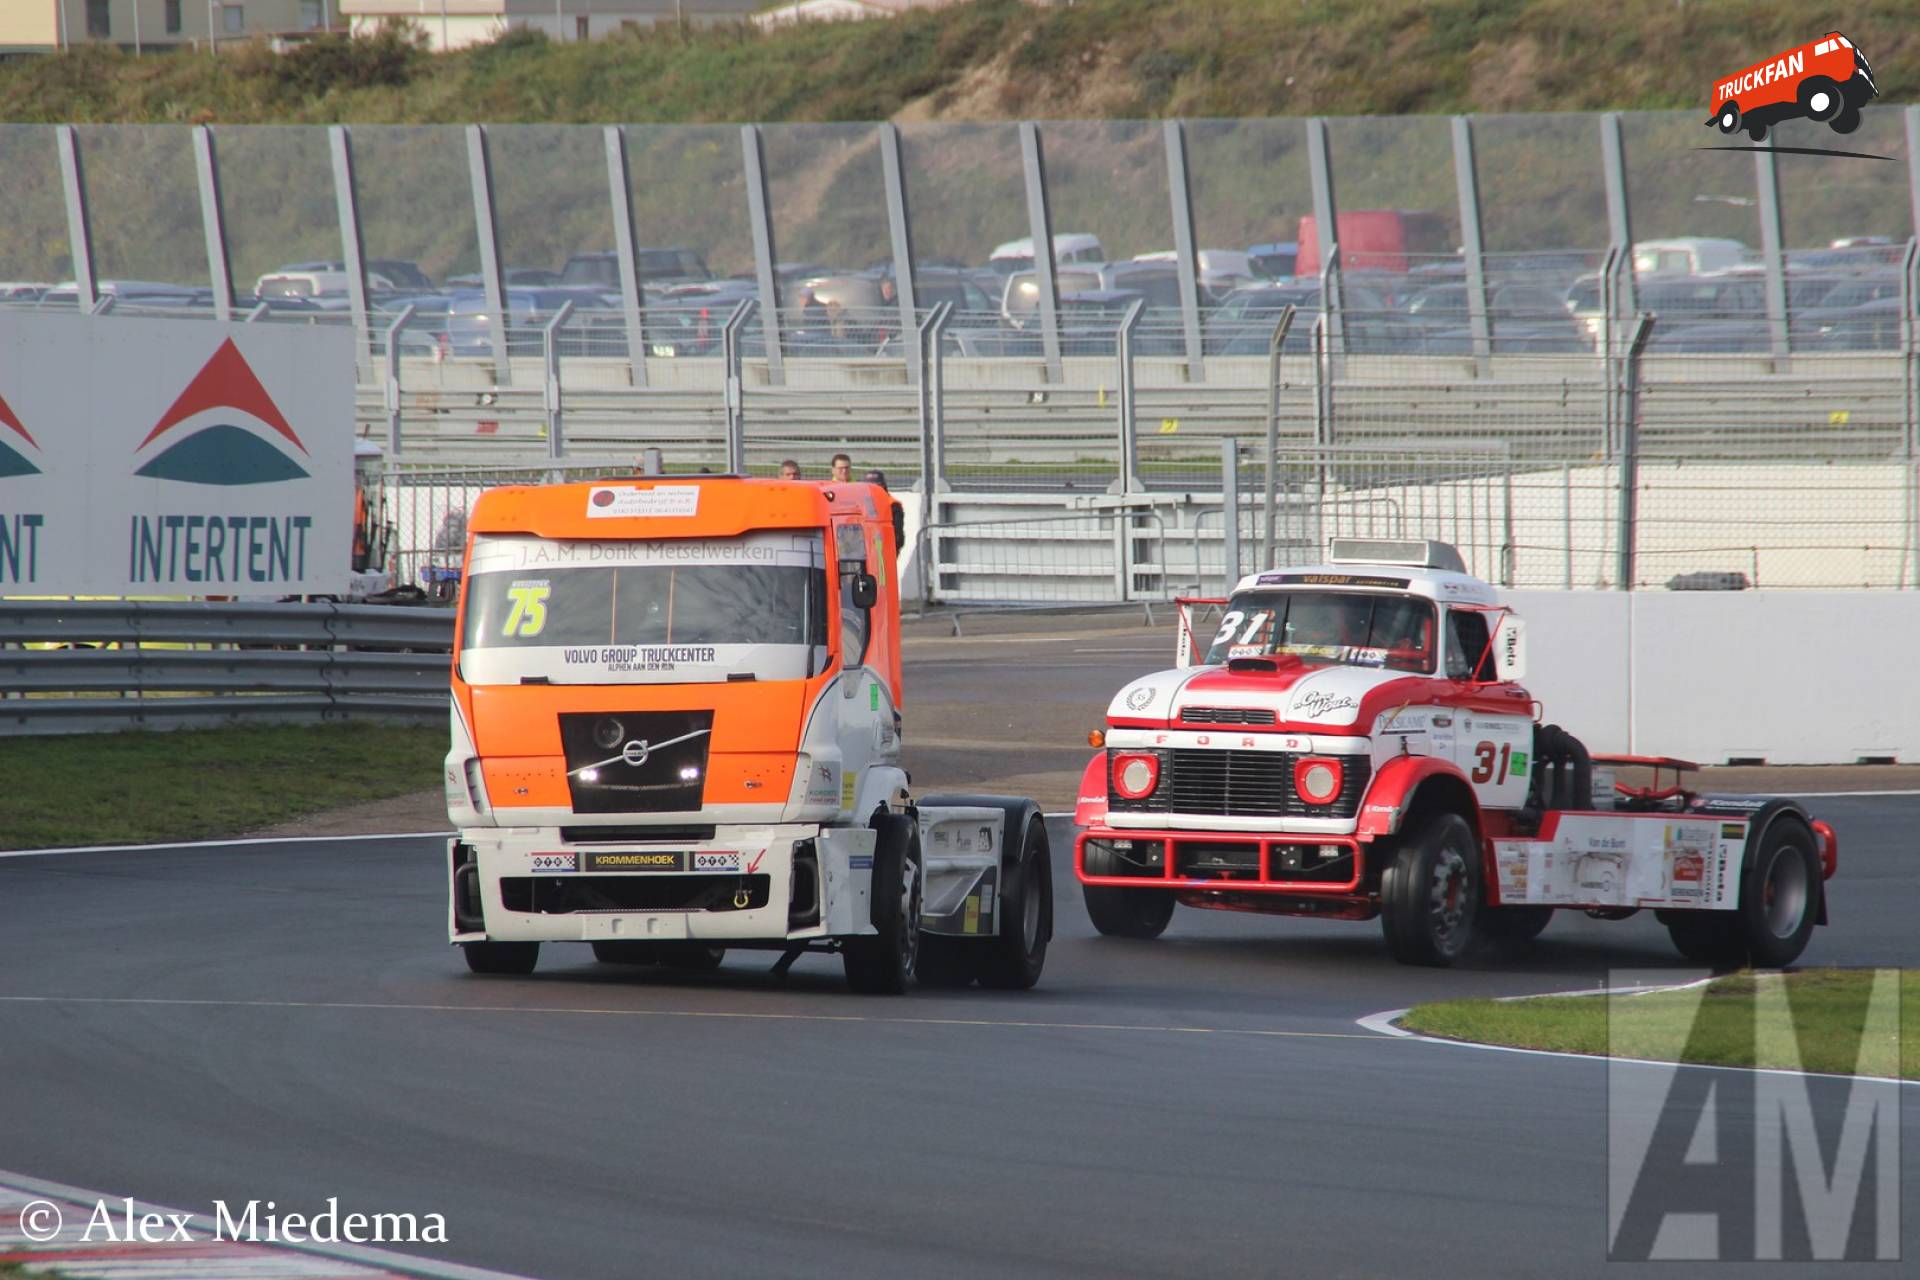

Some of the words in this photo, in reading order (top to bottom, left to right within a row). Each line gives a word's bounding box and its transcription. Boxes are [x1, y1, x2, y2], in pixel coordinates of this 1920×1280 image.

[129, 515, 312, 583] INTERTENT
[520, 543, 580, 566] J.A.M.
[590, 542, 638, 561] Donk
[646, 541, 774, 560] Metselwerken
[1303, 575, 1351, 585] valspar
[502, 586, 551, 638] 75
[1212, 610, 1269, 647] 31
[564, 649, 598, 664] VOLVO
[601, 648, 637, 663] GROUP
[641, 647, 715, 662] TRUCKCENTER
[1507, 638, 1517, 667] Beta
[608, 663, 631, 672] ALPHEN
[632, 663, 646, 671] AAN
[647, 663, 660, 671] DEN
[1156, 735, 1299, 748] FORD
[1471, 740, 1511, 786] 31
[596, 855, 674, 865] KROMMENHOEK
